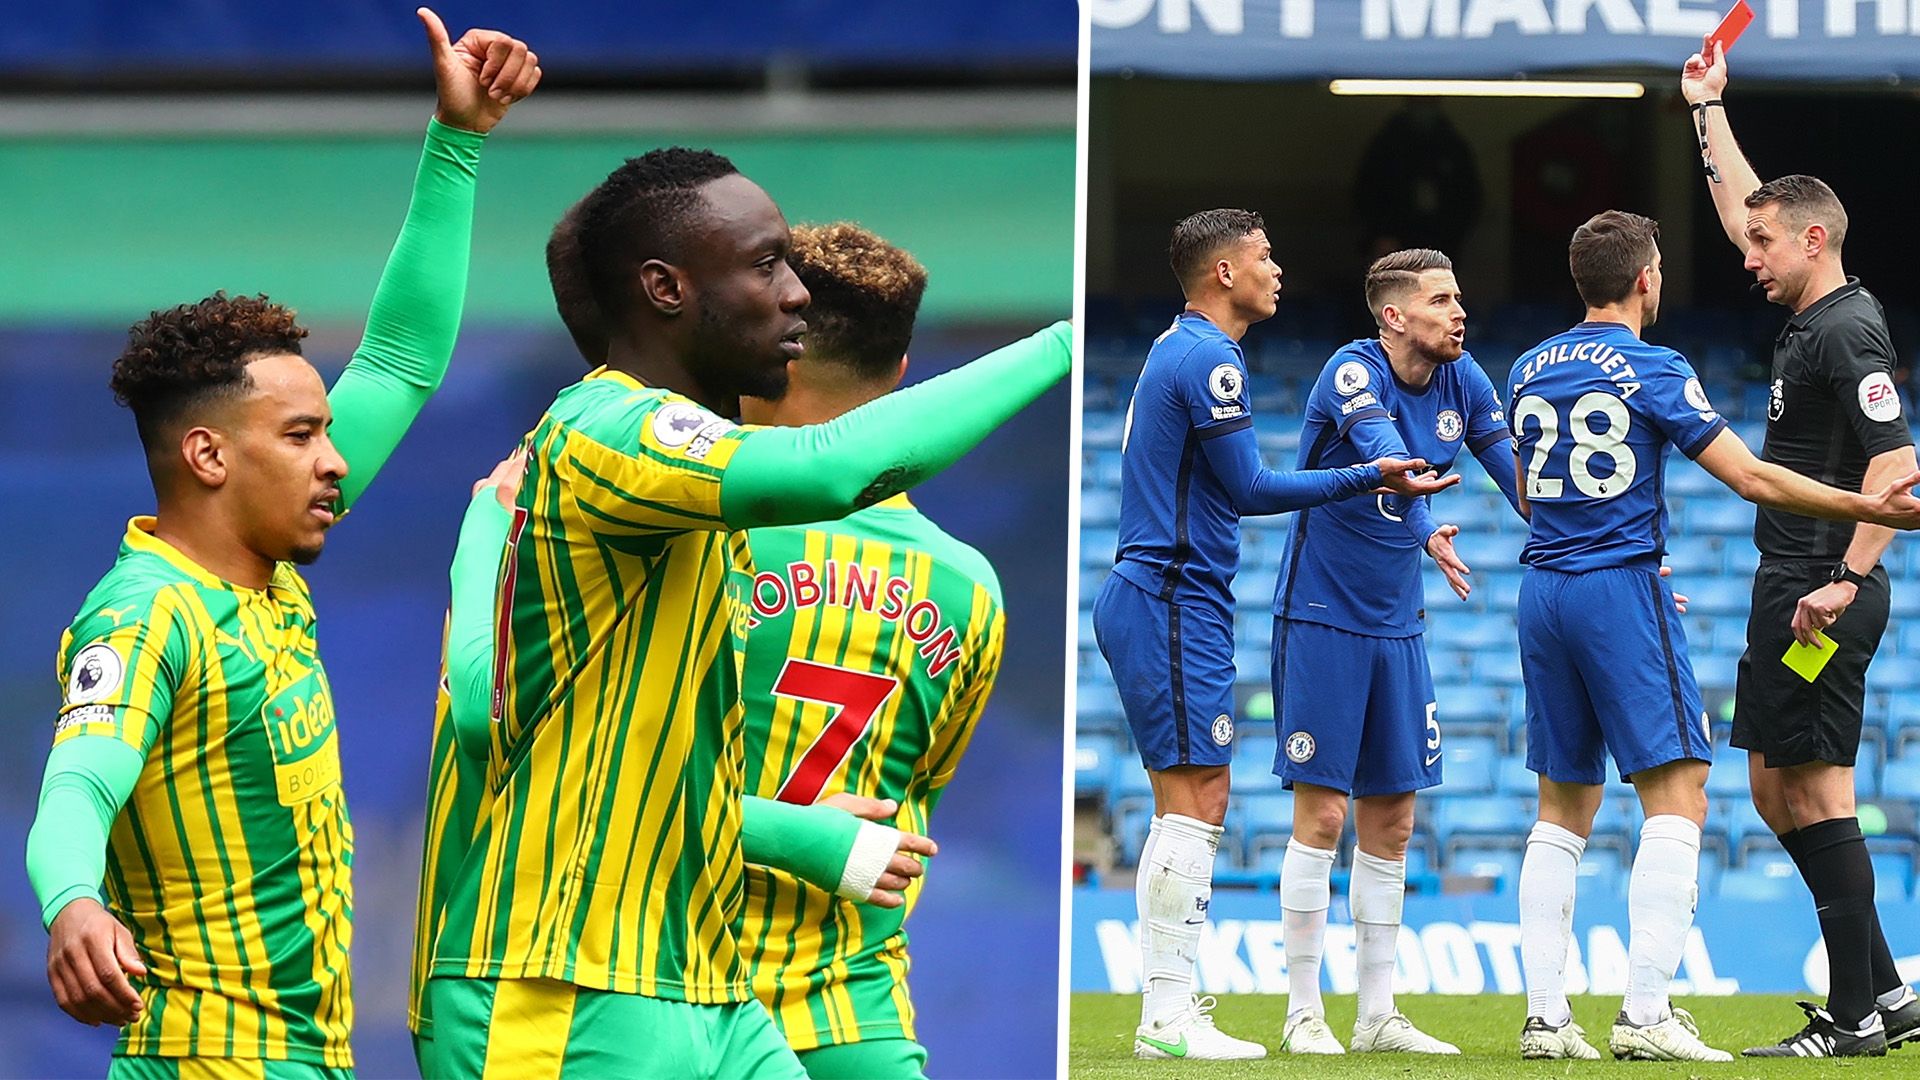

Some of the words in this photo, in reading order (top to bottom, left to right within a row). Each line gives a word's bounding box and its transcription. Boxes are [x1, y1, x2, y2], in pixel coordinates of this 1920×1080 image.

[1867, 384, 1892, 403] EA
[1514, 392, 1637, 499] 28
[748, 560, 962, 679] OBINSON
[275, 671, 335, 755] ideal
[770, 656, 900, 806] 7
[1425, 701, 1441, 750] 5
[1096, 919, 1292, 995] NKE
